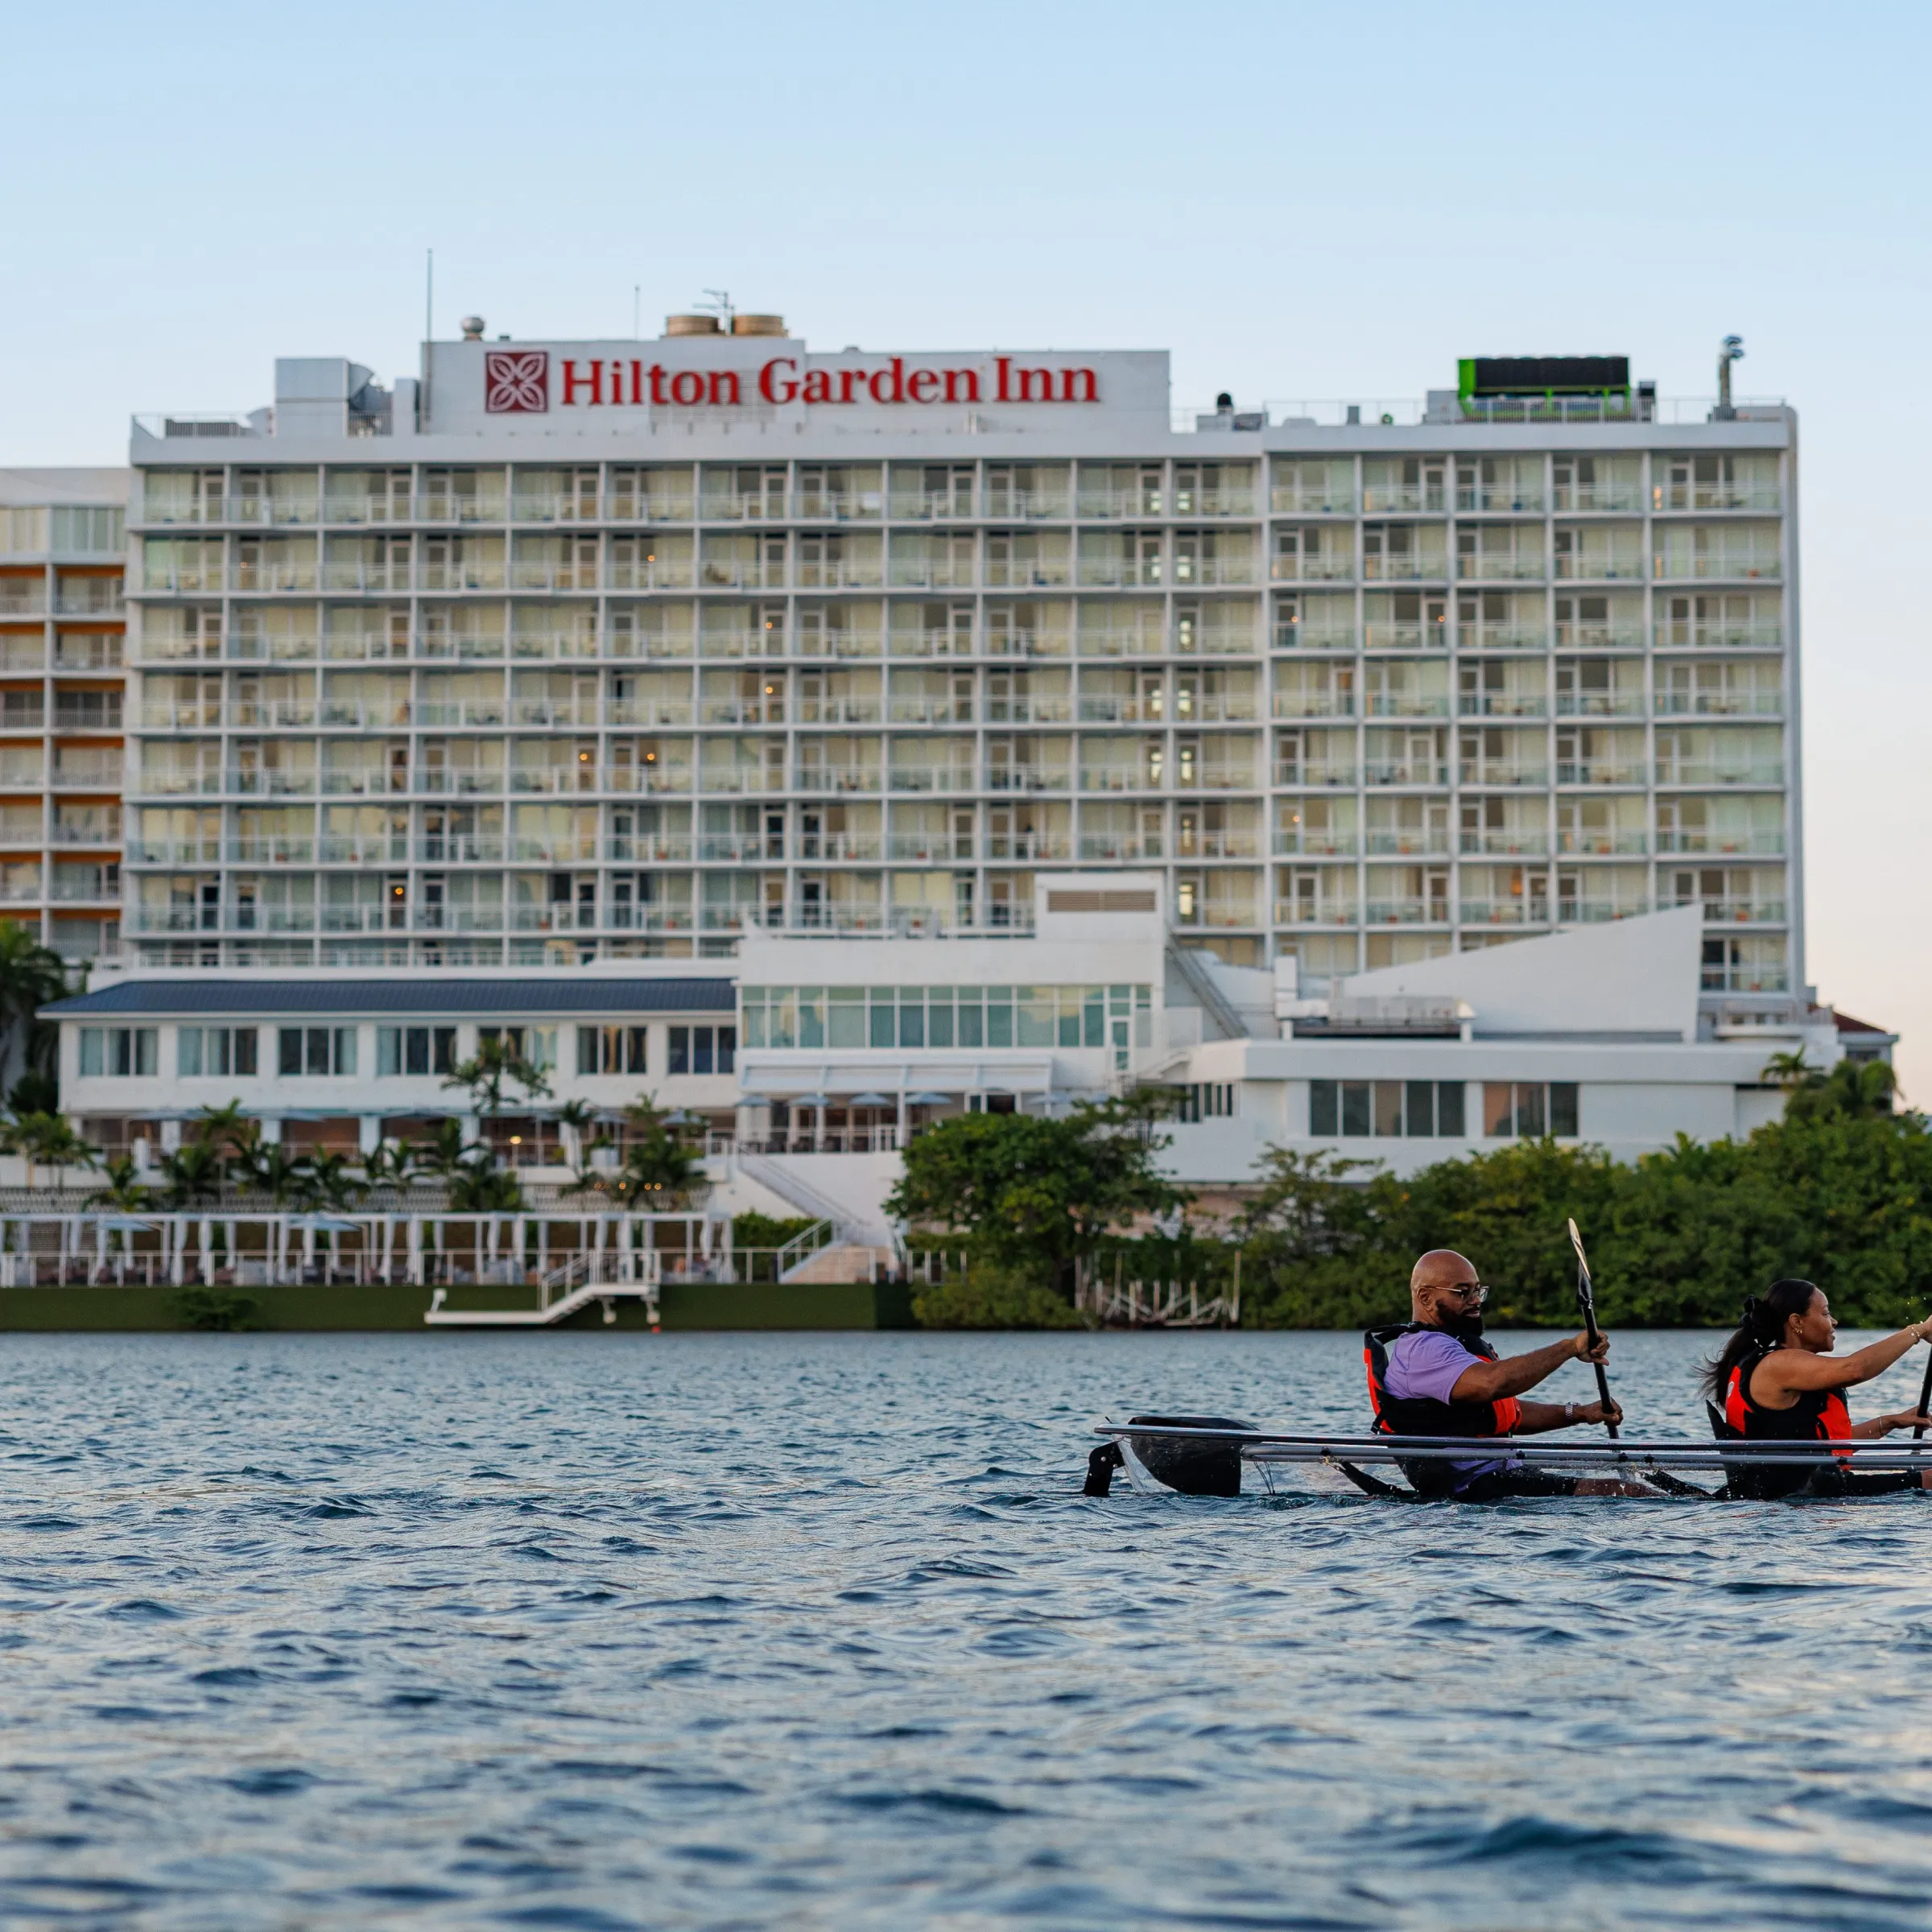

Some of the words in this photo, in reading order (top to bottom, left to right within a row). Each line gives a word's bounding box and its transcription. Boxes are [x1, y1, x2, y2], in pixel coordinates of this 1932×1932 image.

[561, 358, 741, 405] Hilton
[759, 357, 982, 404] Garden
[993, 356, 1100, 402] Inn
